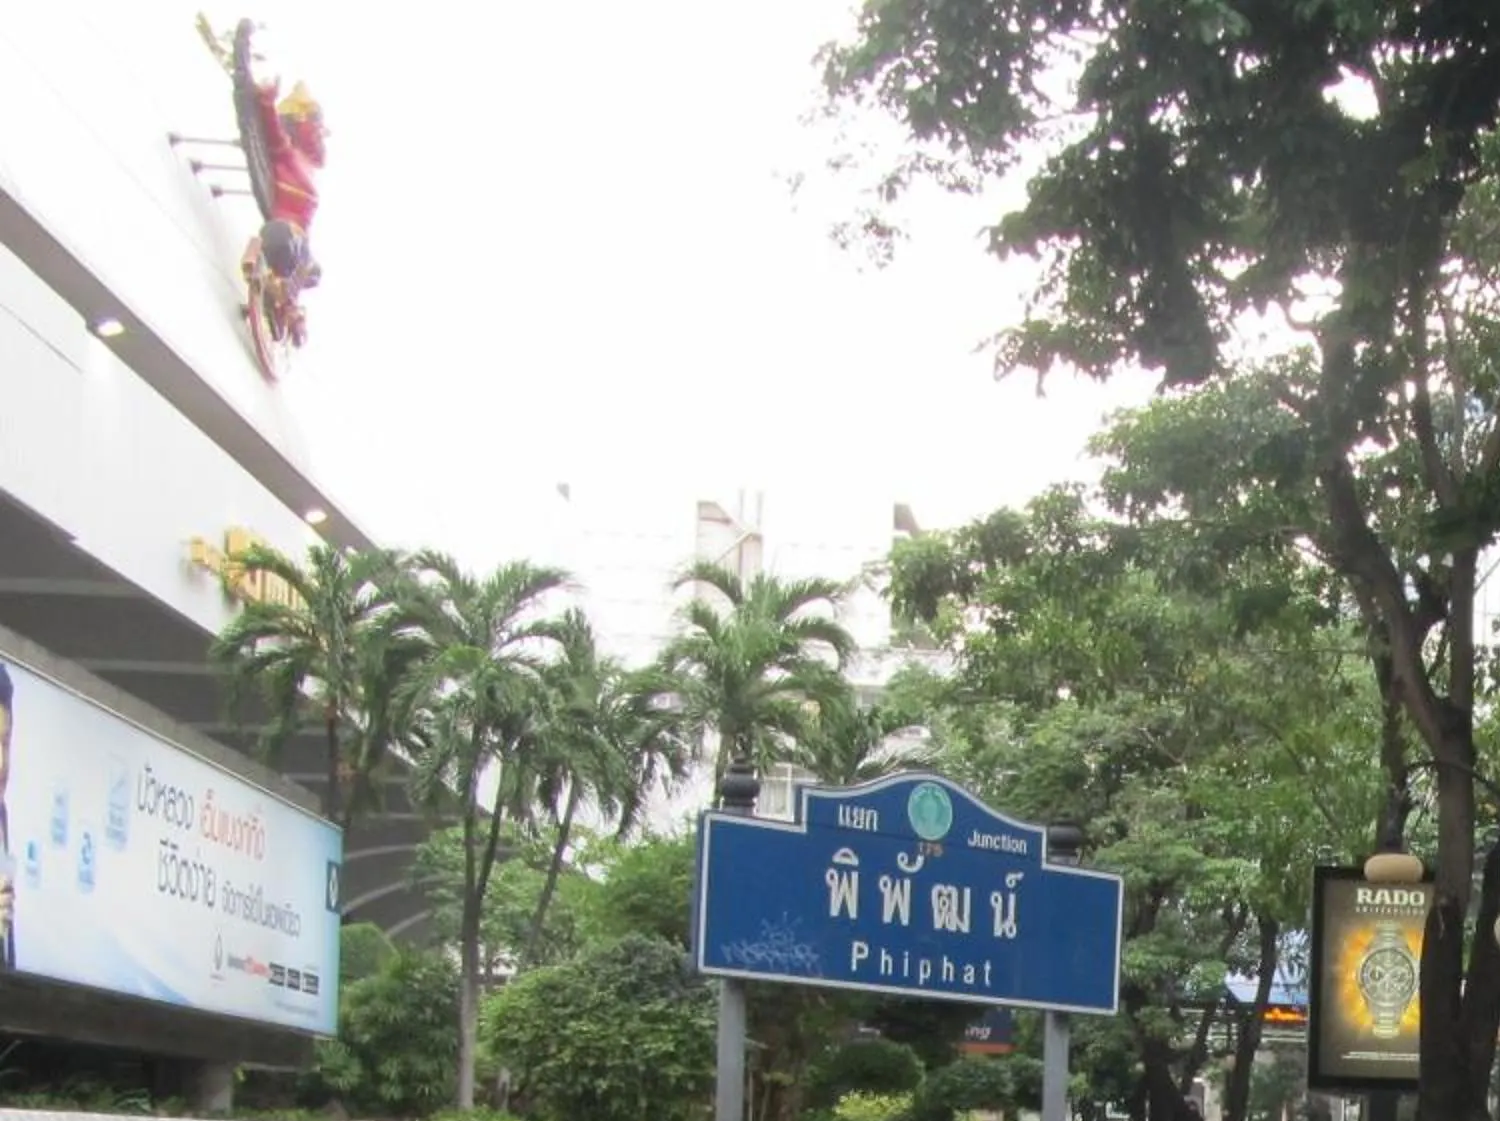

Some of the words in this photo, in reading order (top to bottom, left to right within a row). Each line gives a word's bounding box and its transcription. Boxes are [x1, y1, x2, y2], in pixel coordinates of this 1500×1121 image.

[838, 804, 879, 832] แยก
[967, 830, 1028, 856] Junction
[1356, 887, 1425, 906] RADO
[851, 941, 992, 988] Phiphat
